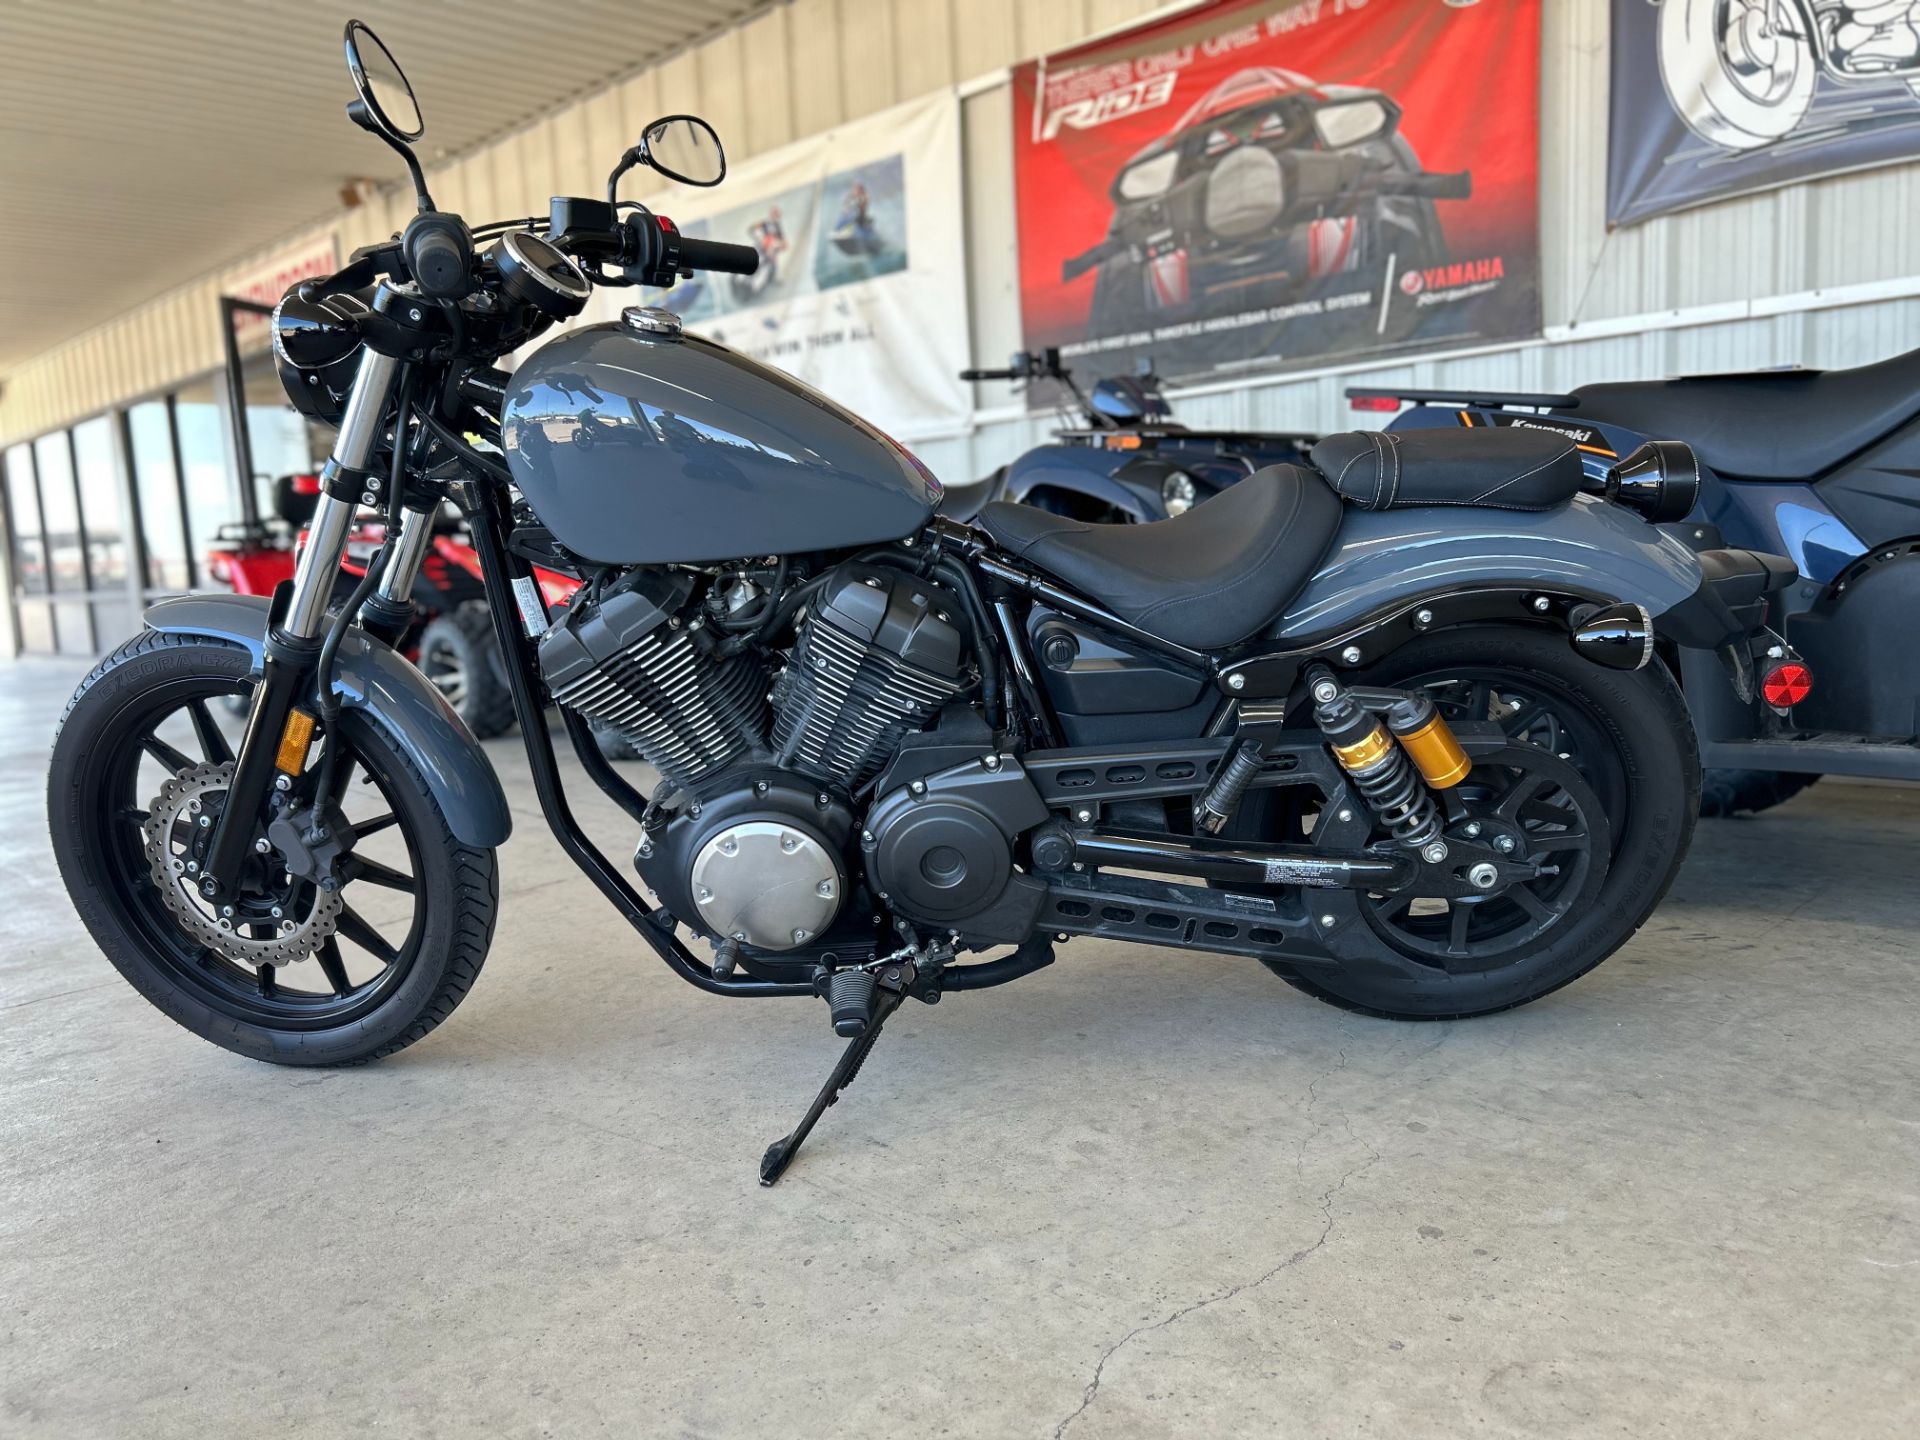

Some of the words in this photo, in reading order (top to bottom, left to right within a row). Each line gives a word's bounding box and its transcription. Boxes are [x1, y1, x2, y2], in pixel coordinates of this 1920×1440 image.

[1136, 43, 1196, 80] ONLY
[1042, 70, 1178, 141] RIDE
[1424, 256, 1504, 290] YAMAHA
[1269, 299, 1322, 322] CONTROL
[1325, 290, 1372, 311] SYSTEM
